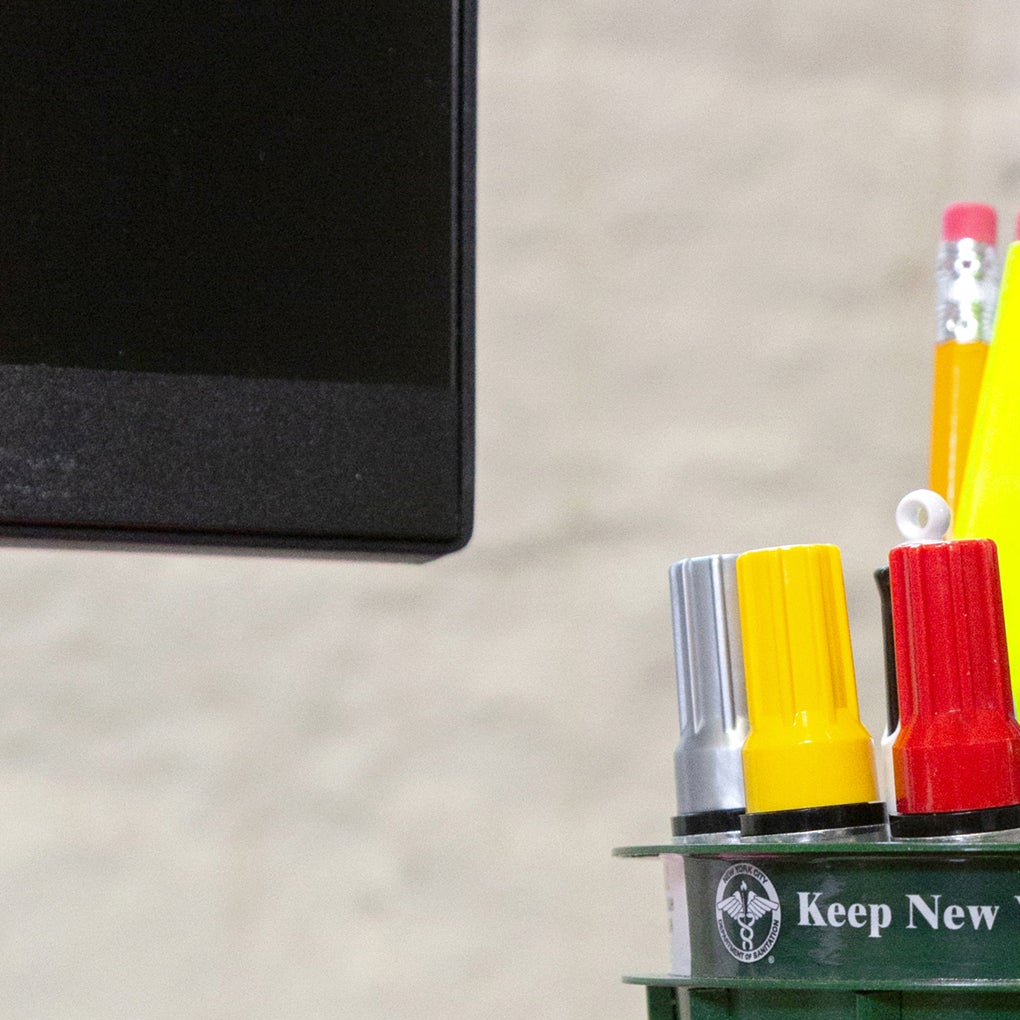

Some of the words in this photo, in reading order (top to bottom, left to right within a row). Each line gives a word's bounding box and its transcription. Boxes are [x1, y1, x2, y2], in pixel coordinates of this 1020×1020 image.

[735, 864, 752, 874] YORK
[752, 867, 769, 884] CITY
[796, 891, 893, 938] Keep
[905, 894, 1000, 931] New
[717, 918, 745, 959] DEPARTMENT
[752, 919, 781, 960] SANITATION
